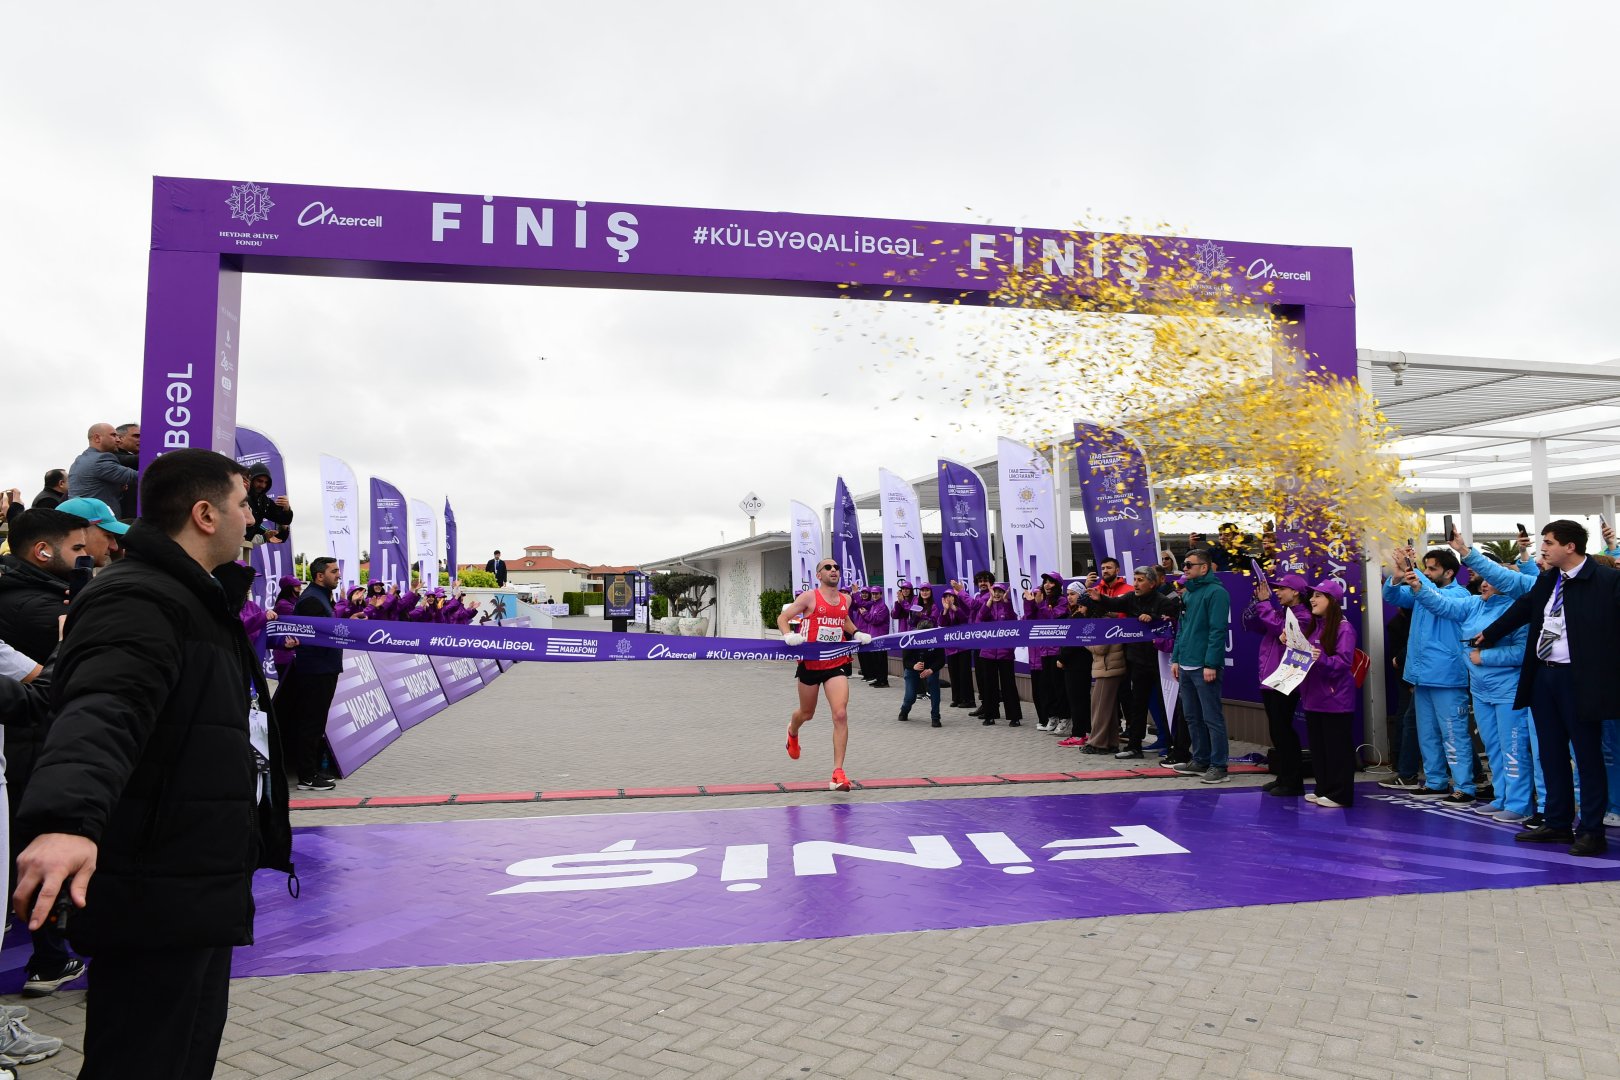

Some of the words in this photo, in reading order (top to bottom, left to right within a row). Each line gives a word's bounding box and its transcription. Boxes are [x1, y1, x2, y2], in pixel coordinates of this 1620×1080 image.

[328, 214, 383, 228] Azercell
[432, 194, 640, 263] FİNİŞ
[219, 231, 251, 239] HEYDƏR
[252, 232, 279, 240] ƏLİYEV
[692, 224, 925, 258] #KÜLƏYƏQALİBGƏL
[235, 239, 263, 247] FONDU
[969, 226, 1148, 290] FİNİŞ
[1269, 268, 1311, 281] Azercell
[156, 362, 194, 457] BGƏL
[1119, 630, 1144, 638] Azercell
[386, 637, 420, 647] Azercell
[429, 635, 535, 651] #KÜLƏYƏQALİBGƏL
[582, 639, 598, 647] BAKI
[559, 645, 598, 654] MARAFONU
[665, 651, 697, 660] Azercell
[345, 685, 391, 730] MARAFONU
[486, 823, 1192, 895] FİNİŞ
